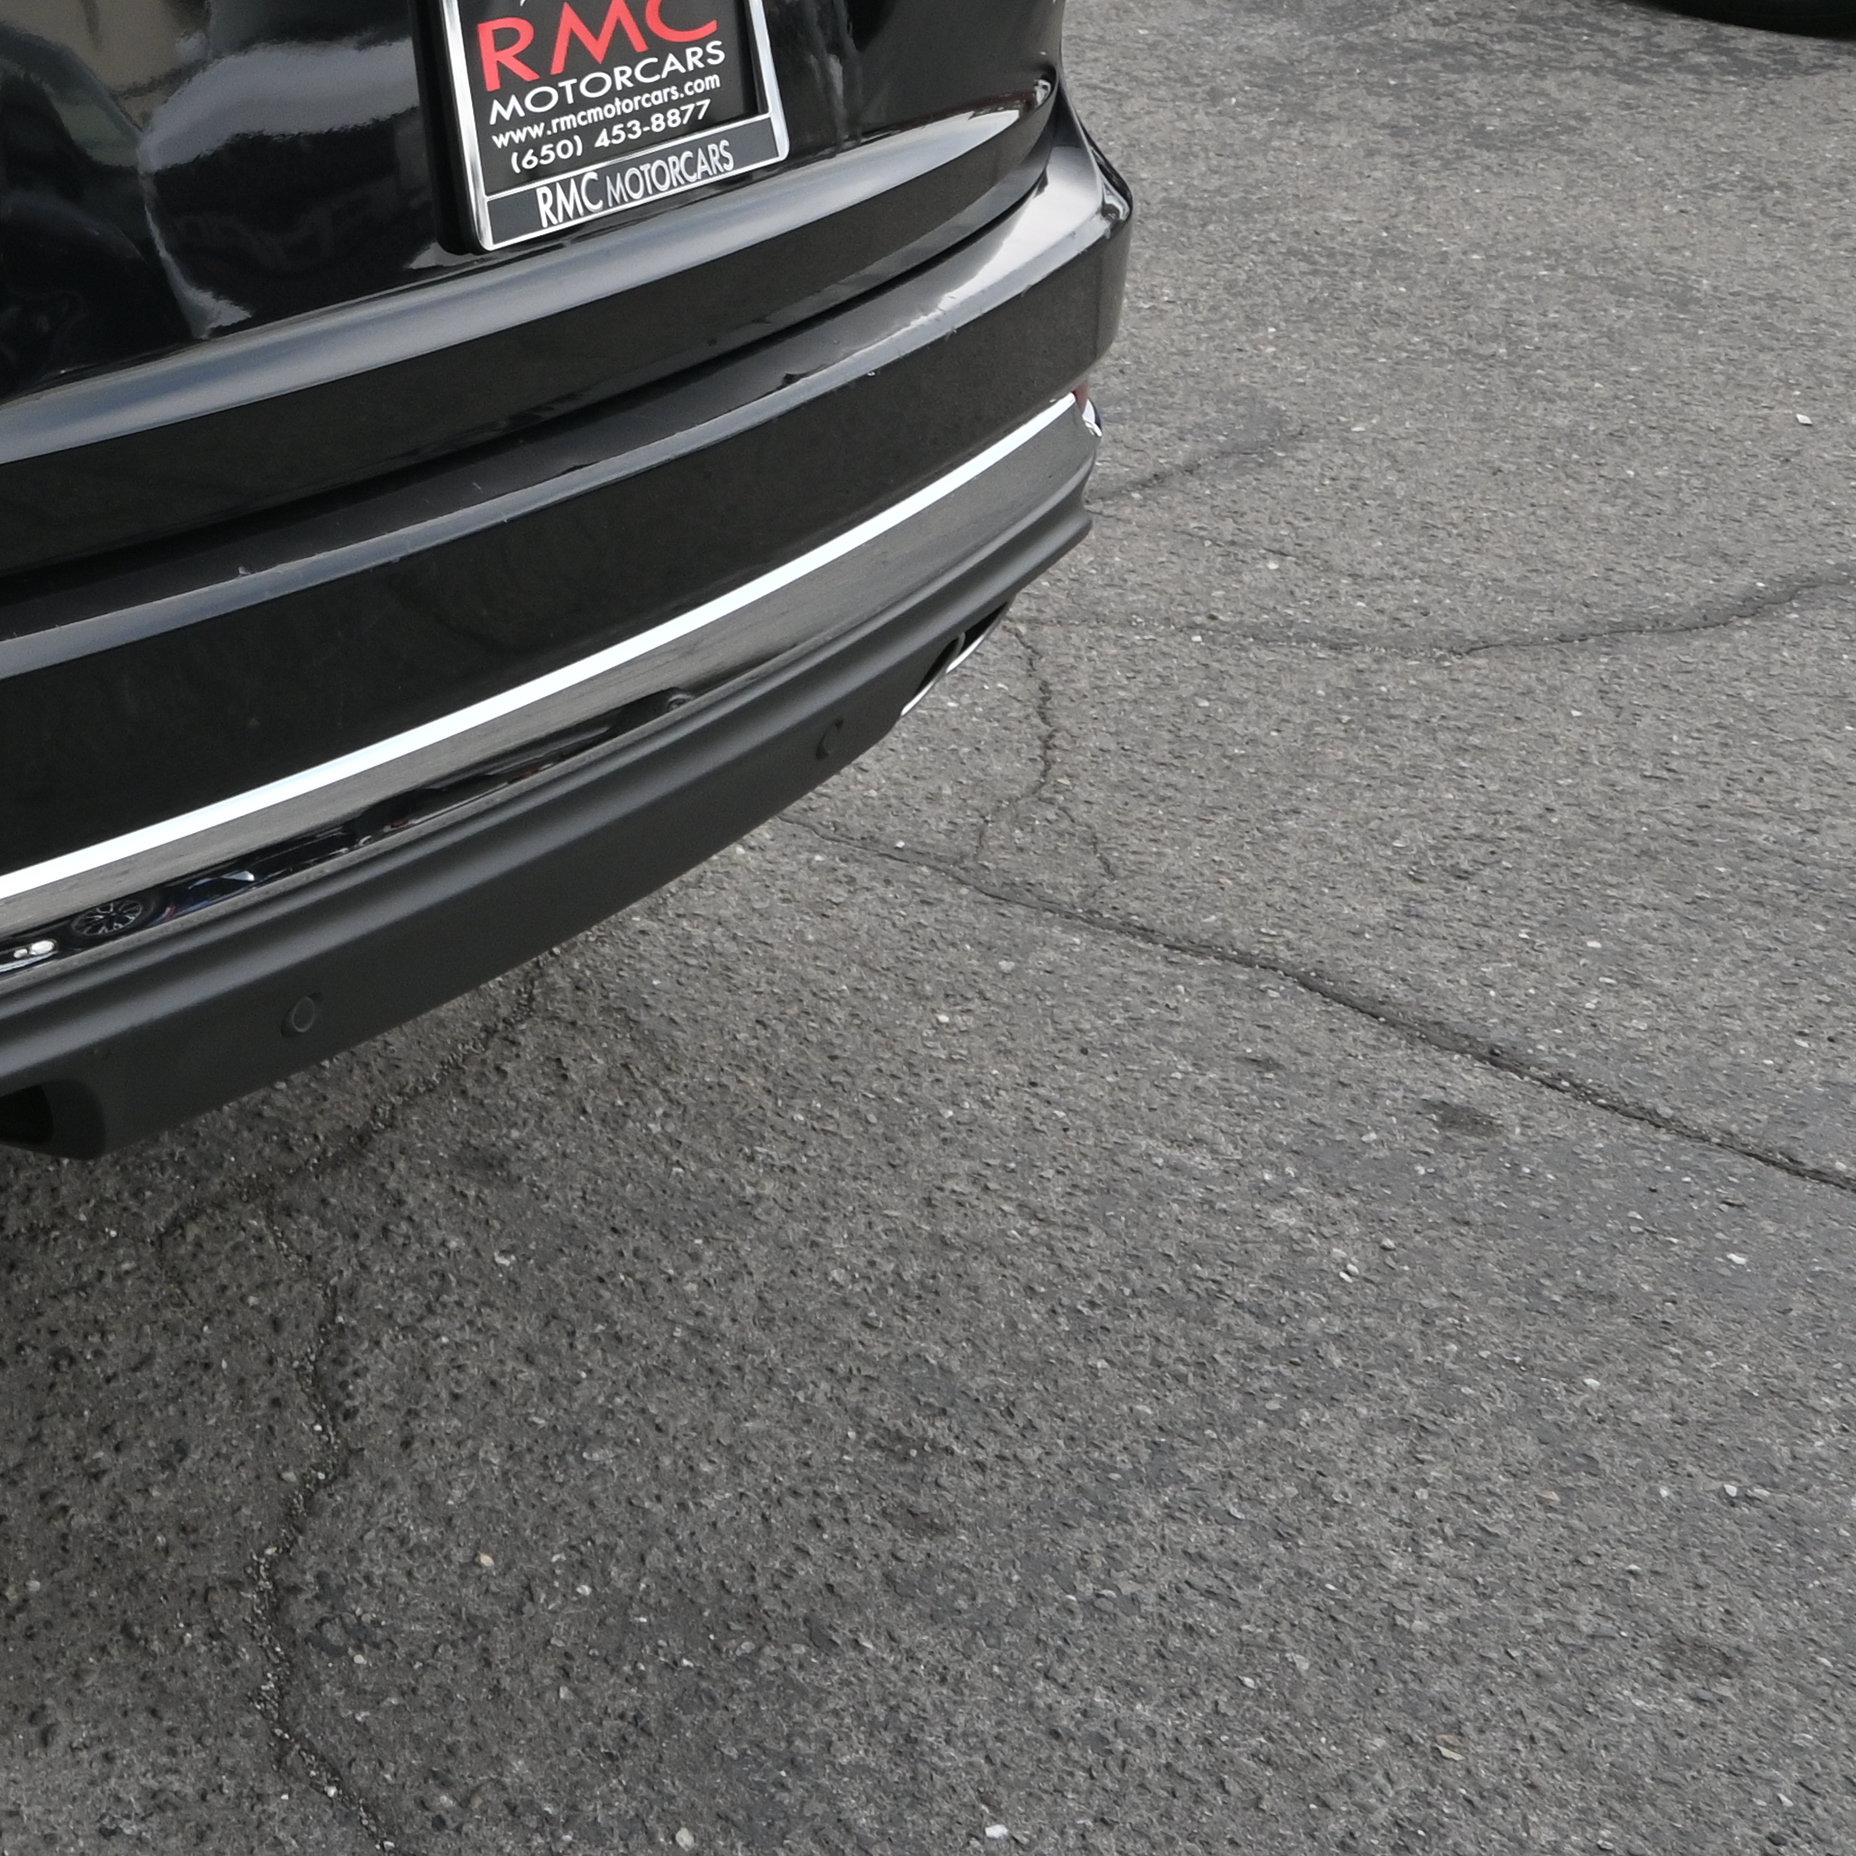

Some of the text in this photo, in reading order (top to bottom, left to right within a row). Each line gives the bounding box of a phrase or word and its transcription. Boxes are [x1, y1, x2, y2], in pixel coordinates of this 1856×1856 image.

[489, 40, 726, 125] MOTORCARS
[491, 72, 721, 149] www.rmcmotorcars.com
[511, 99, 712, 174] (650) 453-8877
[536, 139, 735, 228] RMC MOTORCARS
